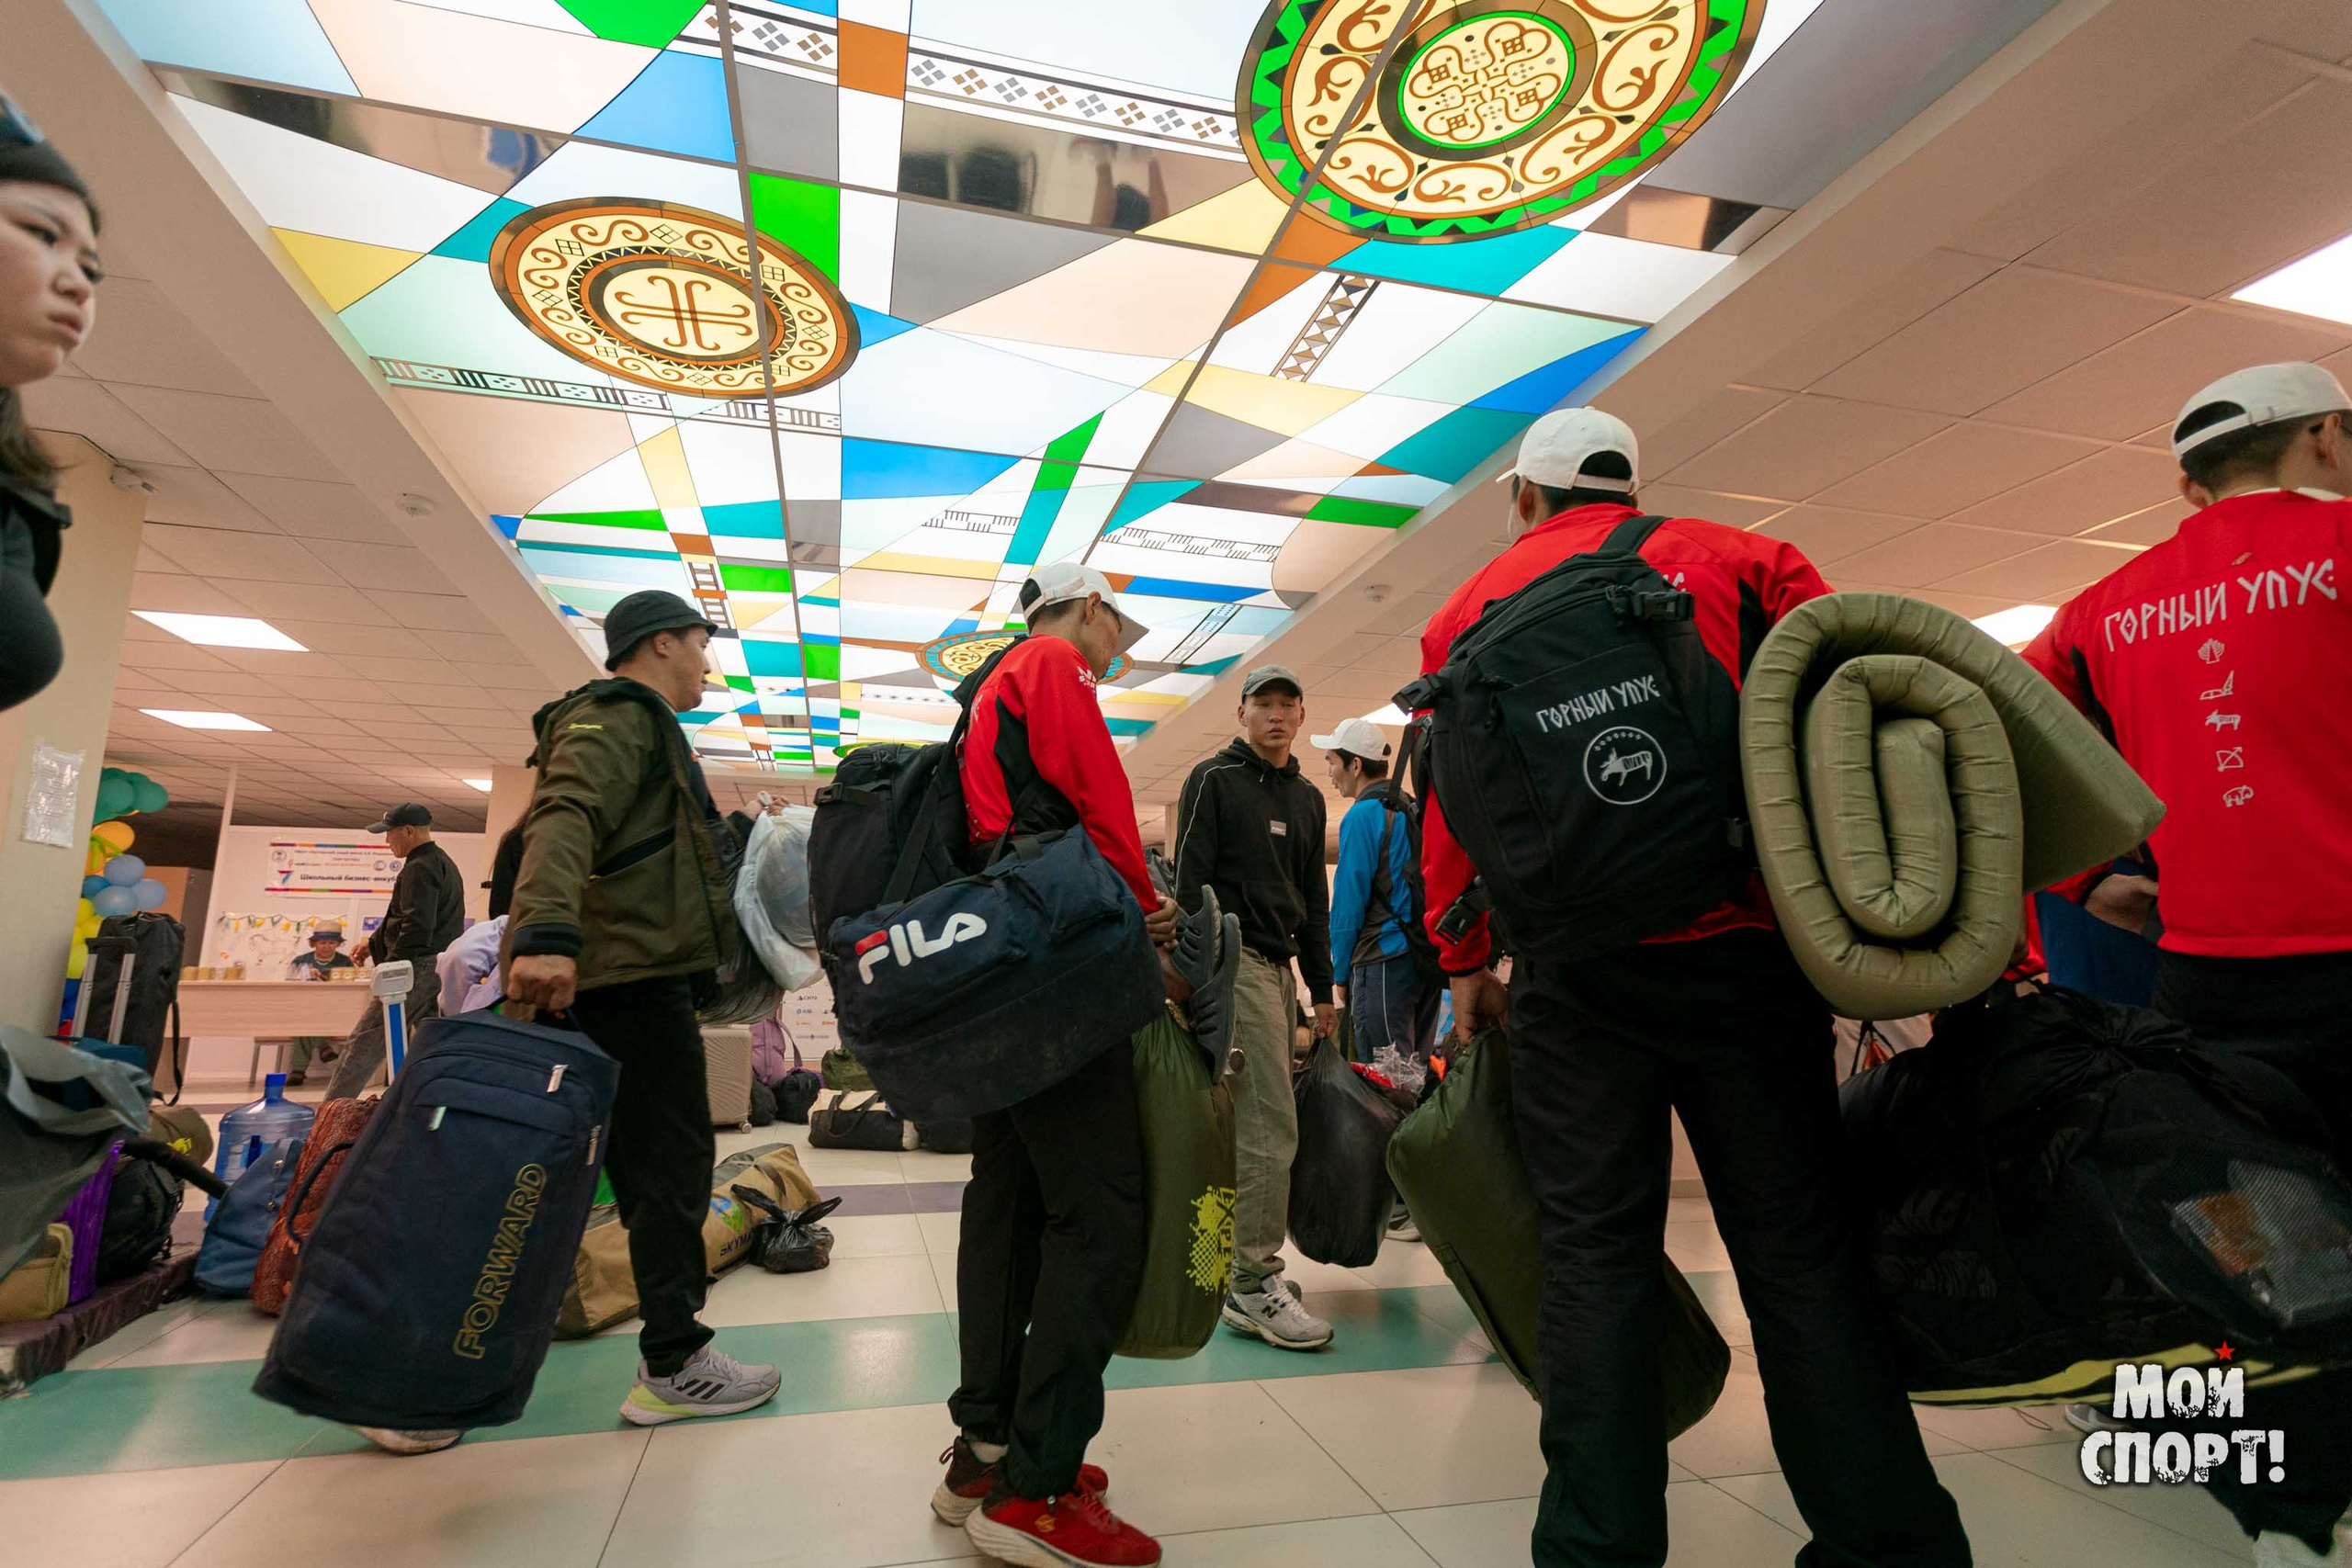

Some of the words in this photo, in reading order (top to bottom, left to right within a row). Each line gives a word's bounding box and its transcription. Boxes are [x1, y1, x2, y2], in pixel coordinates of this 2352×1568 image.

[2104, 581, 2227, 652] ГОРНЫЙ
[1535, 688, 1615, 733] ГОРНЫЙ
[854, 912, 988, 985] FILA
[452, 1163, 548, 1359] FORWARD
